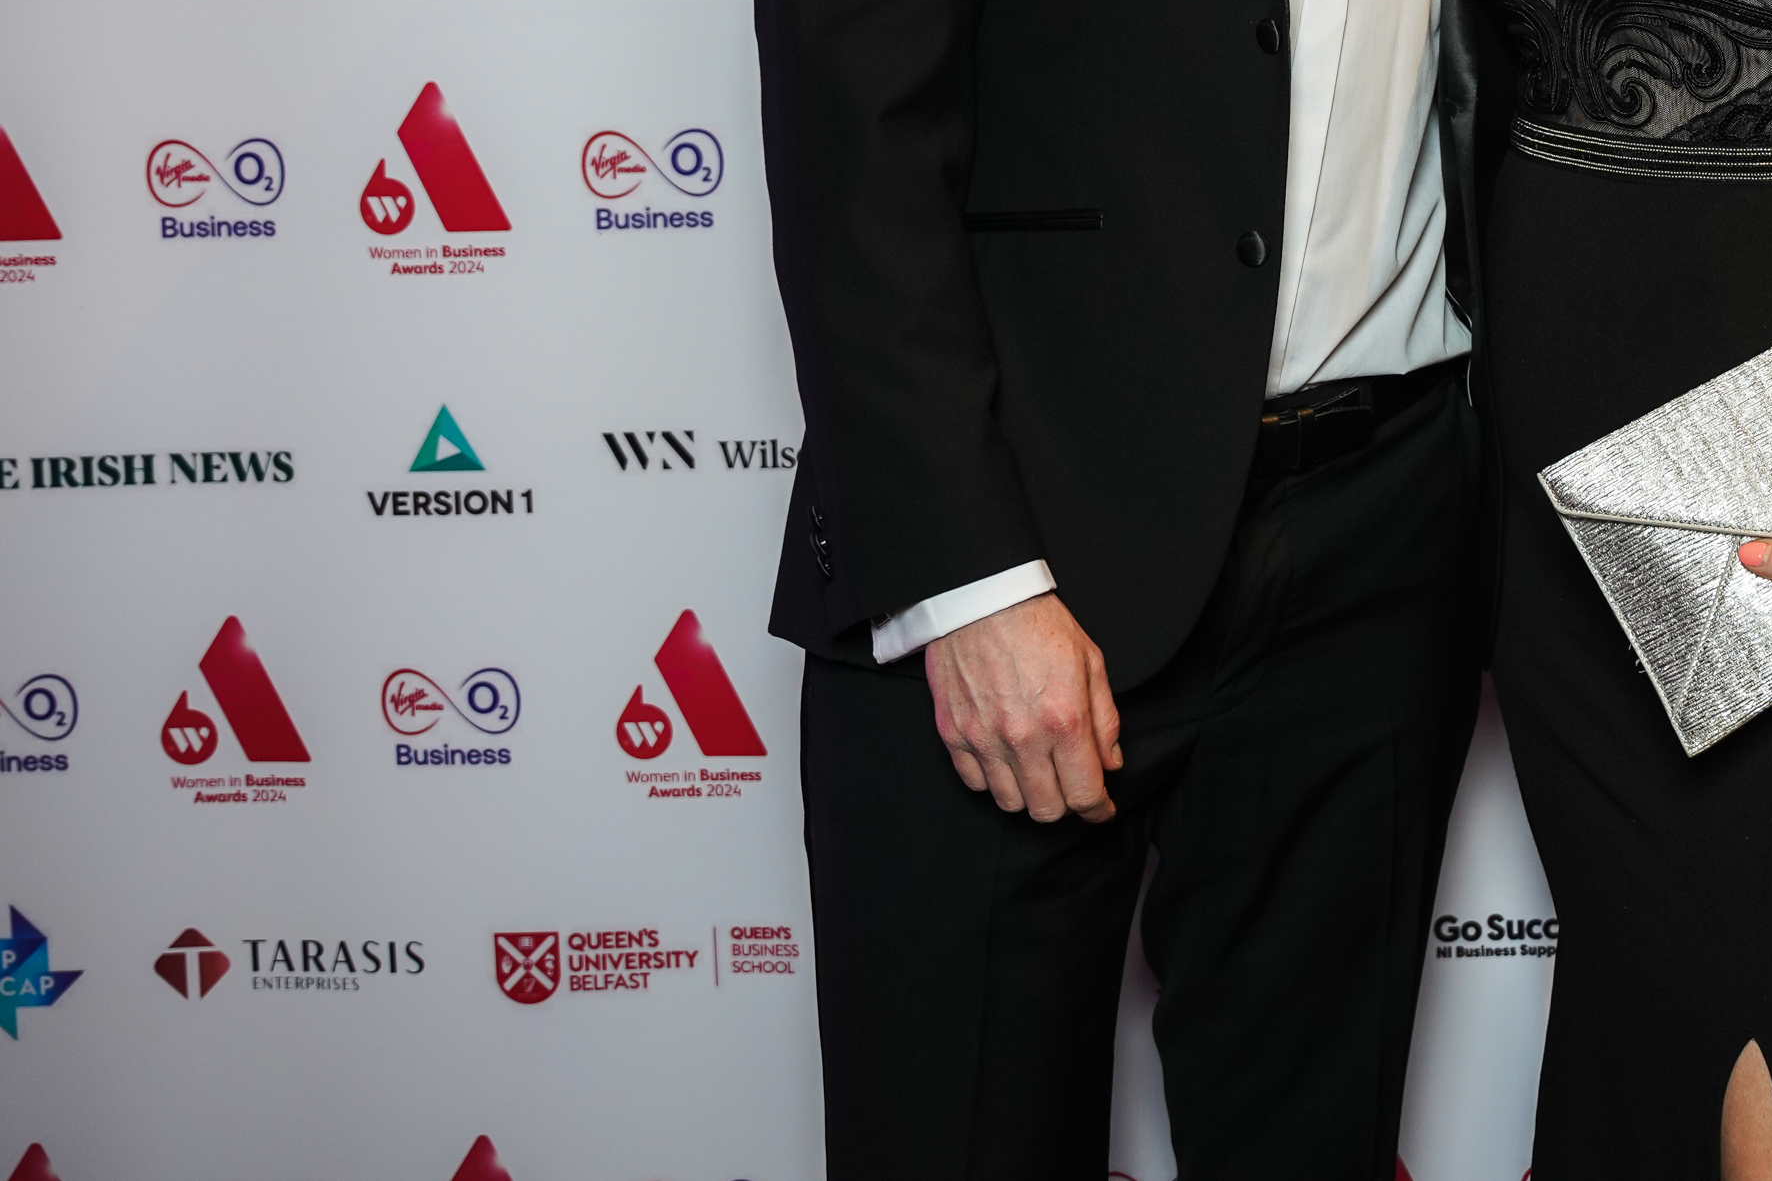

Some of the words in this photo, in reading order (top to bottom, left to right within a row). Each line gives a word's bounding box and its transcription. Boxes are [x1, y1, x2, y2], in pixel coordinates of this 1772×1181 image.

[155, 159, 195, 188] Virgin
[591, 149, 631, 179] Virgin
[617, 163, 647, 175] media
[181, 172, 211, 184] media
[161, 215, 276, 239] Business
[595, 206, 714, 231] Business
[0, 253, 57, 268] usiness
[368, 246, 422, 260] Women
[425, 246, 439, 259] in
[441, 244, 506, 259] Business
[0, 268, 36, 284] 2024
[390, 261, 445, 275] Awards
[448, 260, 485, 274] 2024
[718, 438, 797, 469] Wils
[30, 453, 156, 490] IRISH
[168, 451, 295, 484] NEWS
[366, 489, 514, 517] VERSION
[520, 489, 534, 514] 1
[390, 685, 429, 717] Virgin
[415, 700, 444, 712] media
[0, 750, 69, 774] iness
[395, 743, 512, 766] Business
[170, 776, 226, 790] Women
[228, 775, 242, 788] in
[244, 773, 307, 788] Business
[625, 770, 680, 784] Women
[683, 769, 697, 783] in
[699, 768, 762, 782] Business
[193, 789, 249, 804] Awards
[251, 788, 287, 803] 2024
[648, 784, 703, 798] Awards
[706, 783, 742, 797] 2024
[730, 925, 792, 941] QUEEN'S
[1435, 914, 1482, 940] Go
[1486, 913, 1559, 941] Succ
[567, 927, 660, 952] QUEEN'S
[243, 939, 425, 975] TARASIS
[731, 943, 800, 958] BUSINESS
[1435, 946, 1452, 959] NI
[1455, 944, 1517, 959] Business
[1520, 944, 1557, 959] Supp
[568, 950, 699, 973] UNIVERSITY
[731, 960, 796, 975] SCHOOL
[0, 974, 54, 997] CAP
[251, 975, 360, 991] ENTERPRISES
[569, 971, 651, 992] BELFAST
